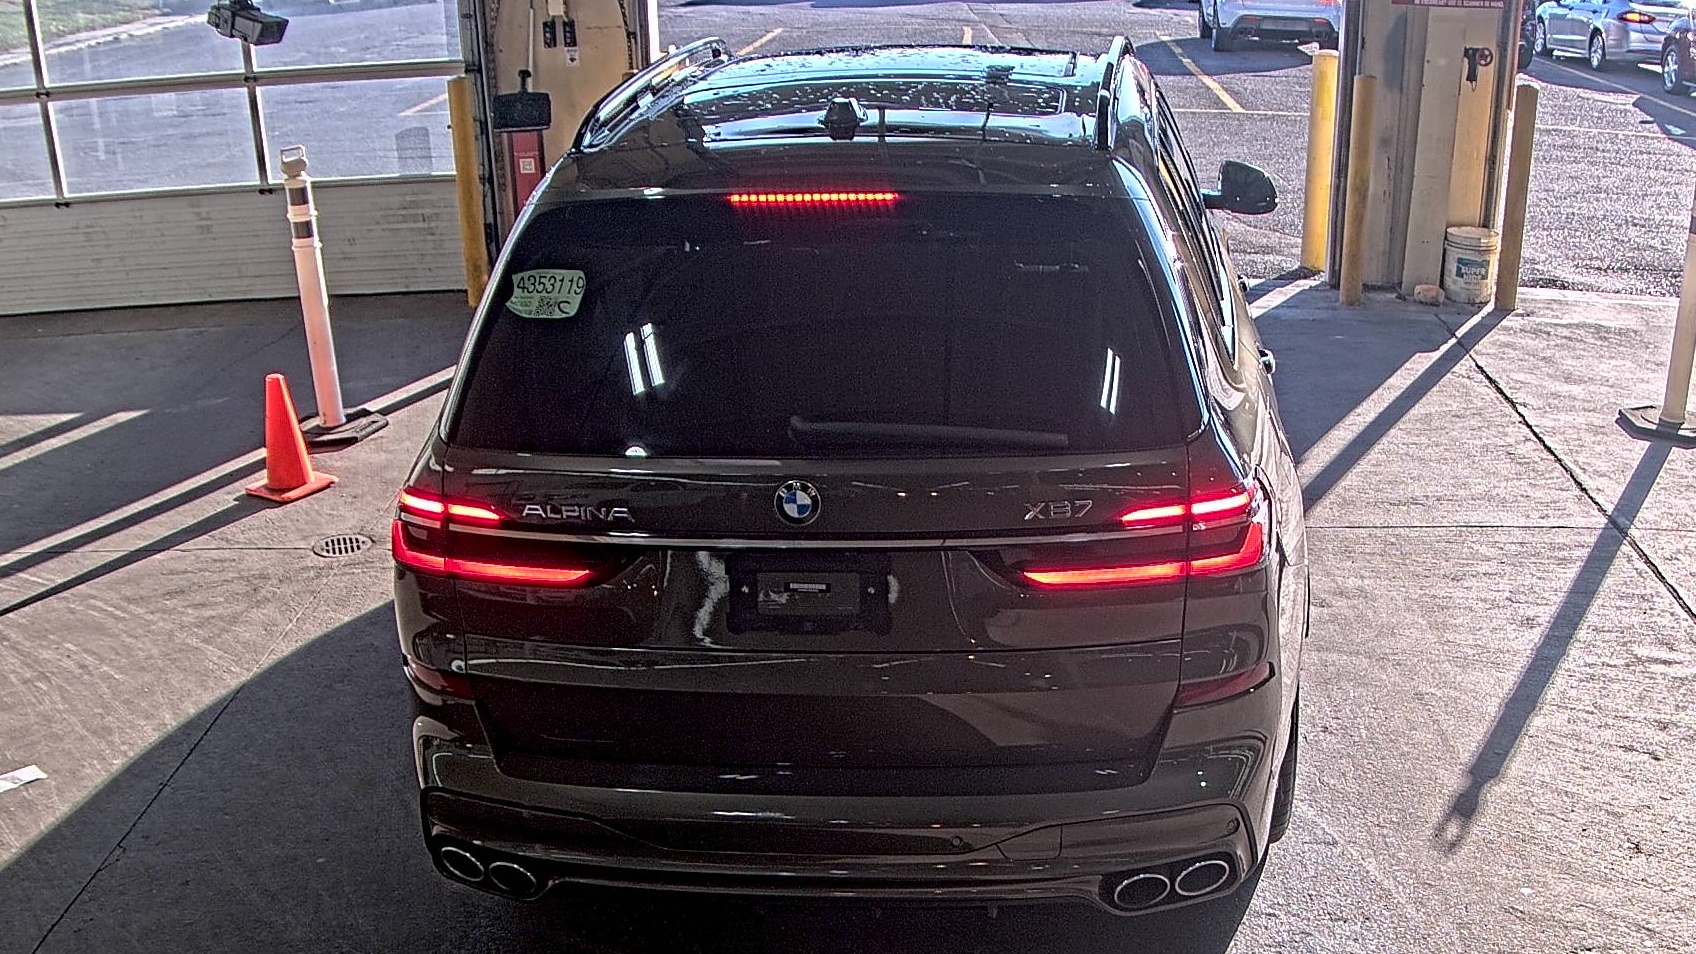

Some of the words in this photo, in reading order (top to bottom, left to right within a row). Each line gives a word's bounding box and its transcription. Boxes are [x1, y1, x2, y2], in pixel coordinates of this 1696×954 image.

[516, 274, 585, 295] 4353119
[558, 300, 571, 315] C
[521, 504, 636, 524] ALPINA
[1023, 499, 1093, 521] XB7
